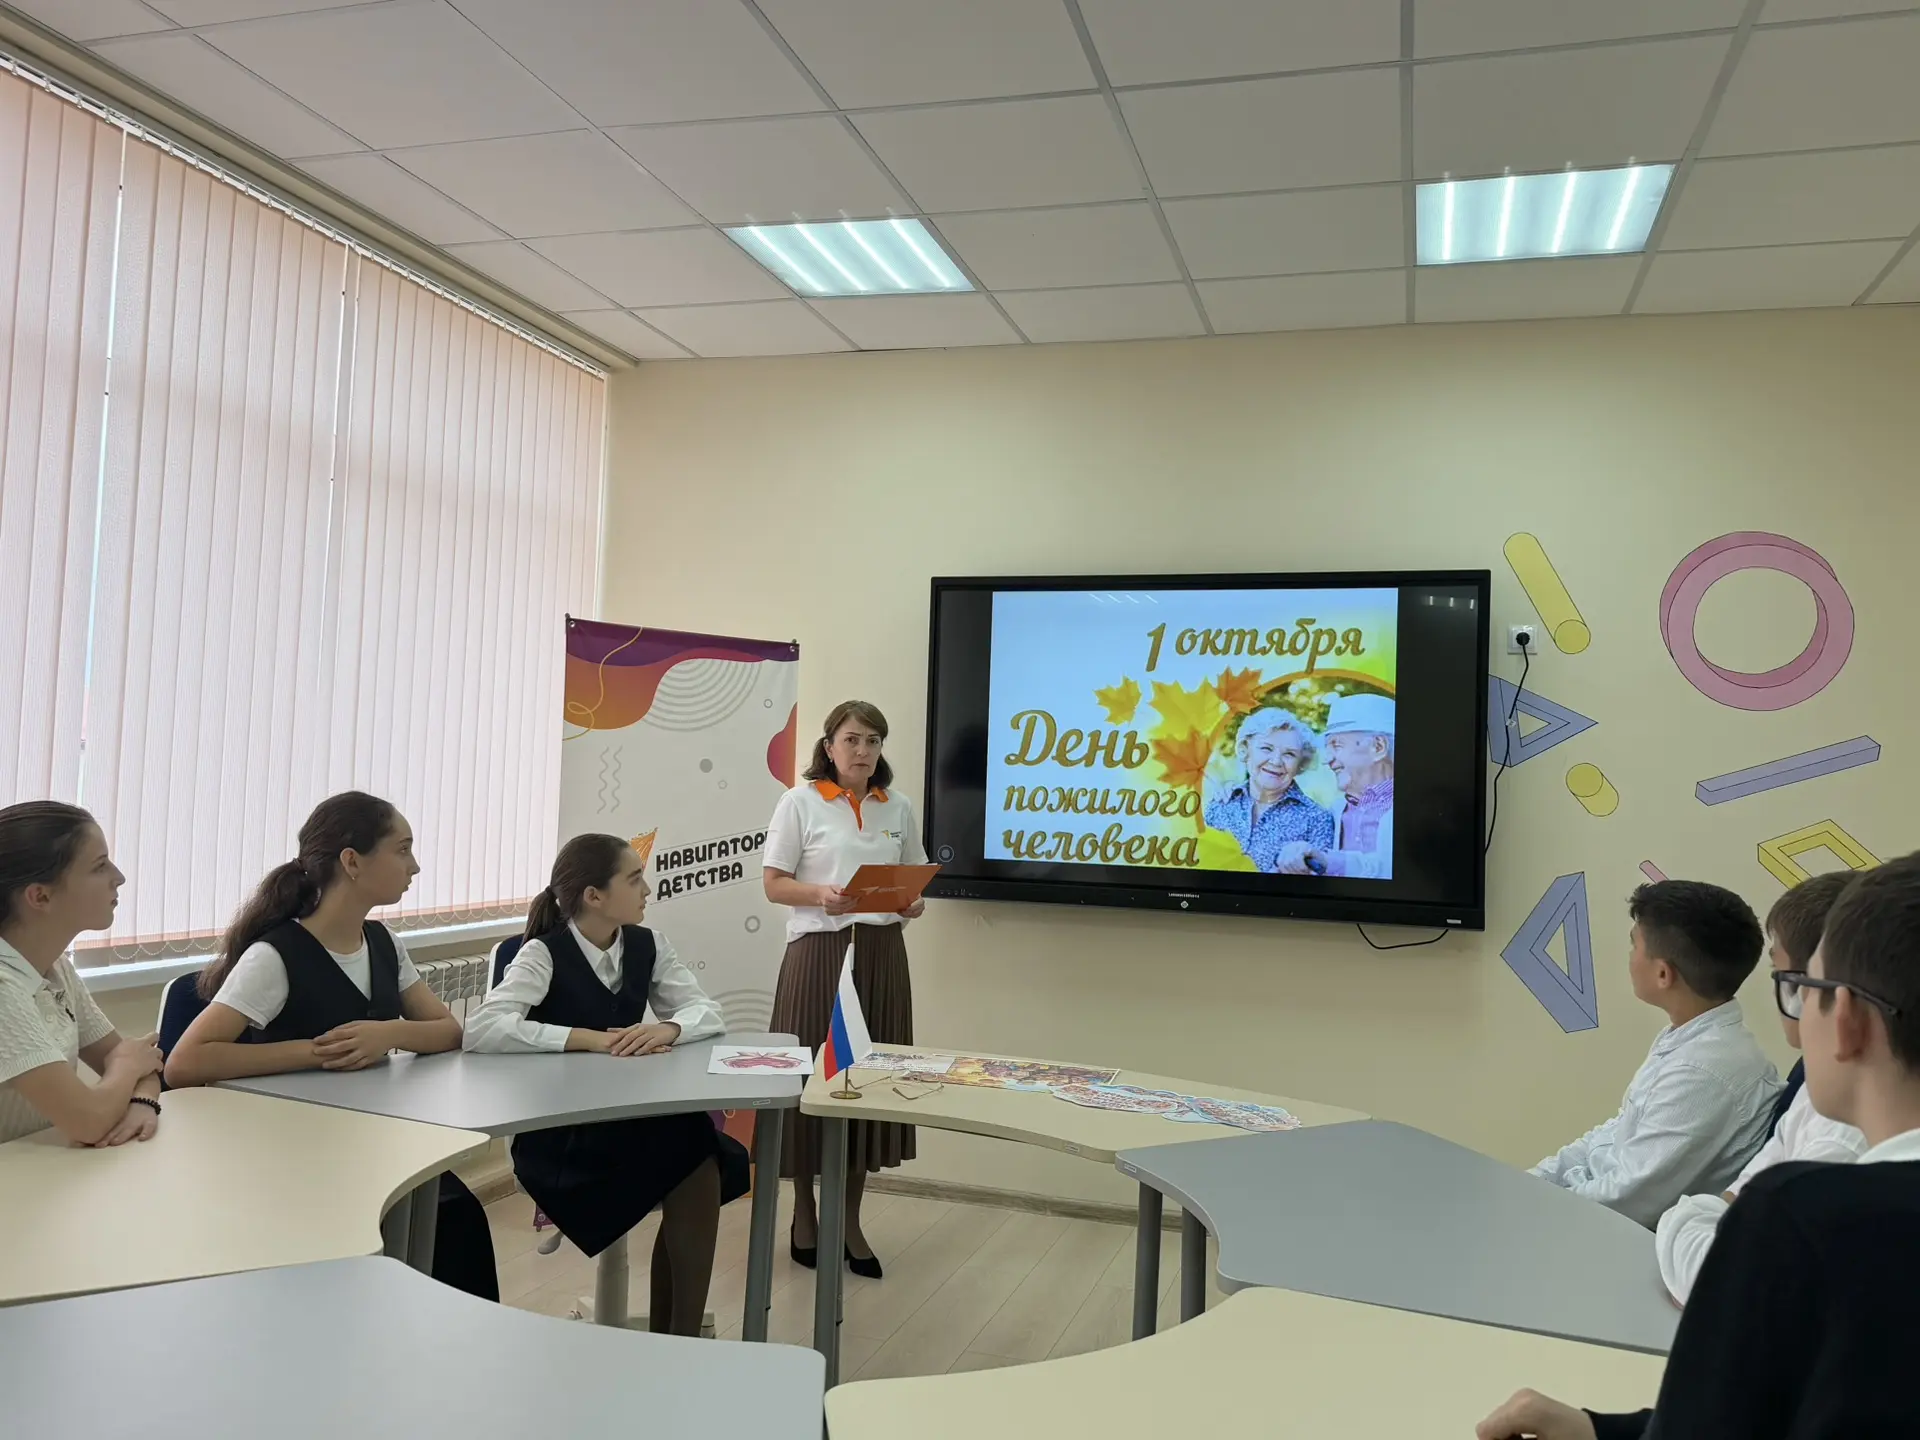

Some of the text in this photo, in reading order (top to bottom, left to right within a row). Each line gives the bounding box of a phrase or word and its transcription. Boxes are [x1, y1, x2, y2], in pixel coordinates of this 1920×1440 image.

[1146, 618, 1366, 674] 1 октября
[1004, 709, 1149, 769] День
[1003, 784, 1200, 818] пожилого
[1002, 822, 1200, 867] человека
[657, 862, 743, 900] ДЕТСТВА
